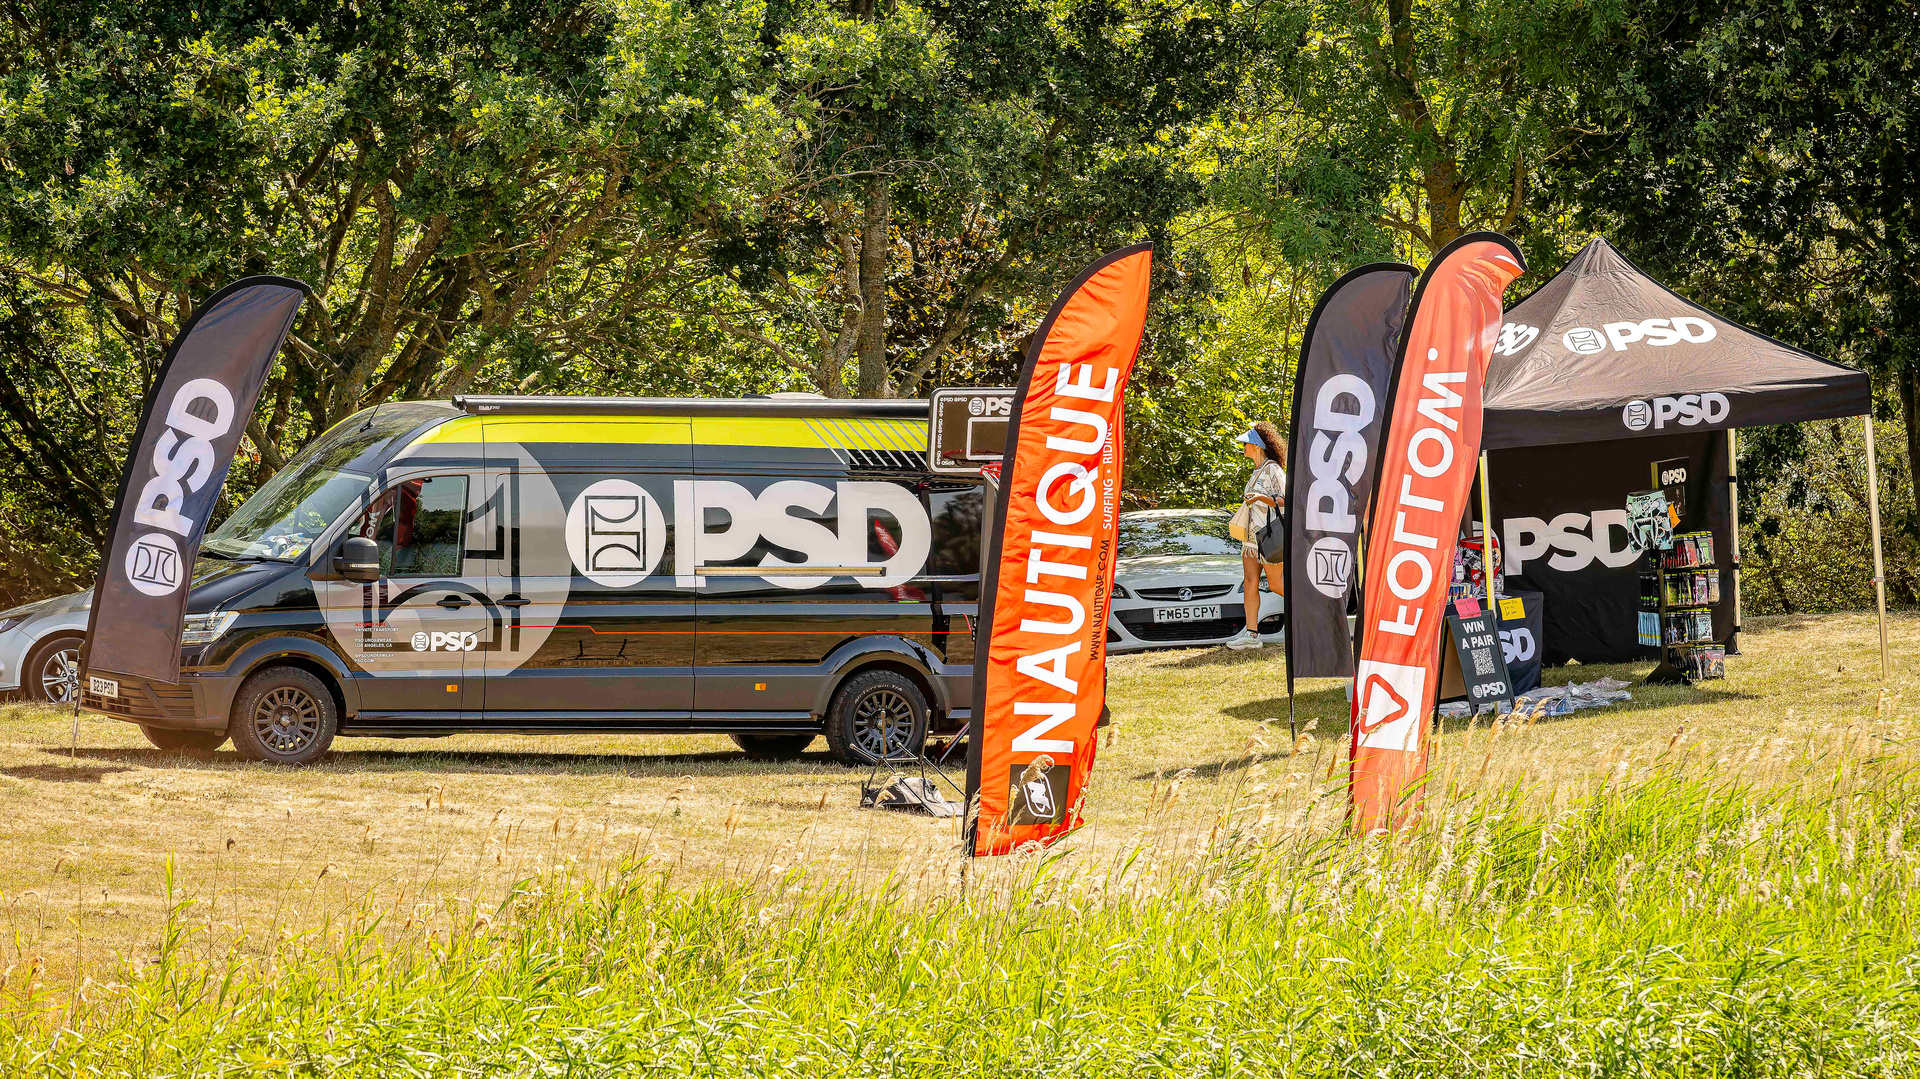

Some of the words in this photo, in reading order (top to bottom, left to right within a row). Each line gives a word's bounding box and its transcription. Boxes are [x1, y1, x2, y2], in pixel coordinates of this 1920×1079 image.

[1603, 317, 1717, 351] PSD
[985, 397, 1014, 416] PS
[1653, 392, 1730, 430] PSD
[133, 378, 235, 538] PSD
[1306, 373, 1376, 533] PSD
[1668, 467, 1687, 485] PSD
[1102, 478, 1114, 530] SURFING
[673, 480, 932, 589] PSD
[1503, 509, 1645, 576] PSD
[1011, 362, 1120, 754] NAUTIQUE
[1090, 539, 1110, 661] WWW.NAUTIQUE.COM
[1159, 608, 1190, 620] FM65
[1193, 606, 1216, 618] CPY
[430, 631, 478, 652] PSD
[1462, 620, 1486, 634] WIN
[1462, 638, 1470, 650] A
[1470, 634, 1495, 648] PAIR
[1498, 627, 1536, 664] SD
[1480, 682, 1506, 698] PSD
